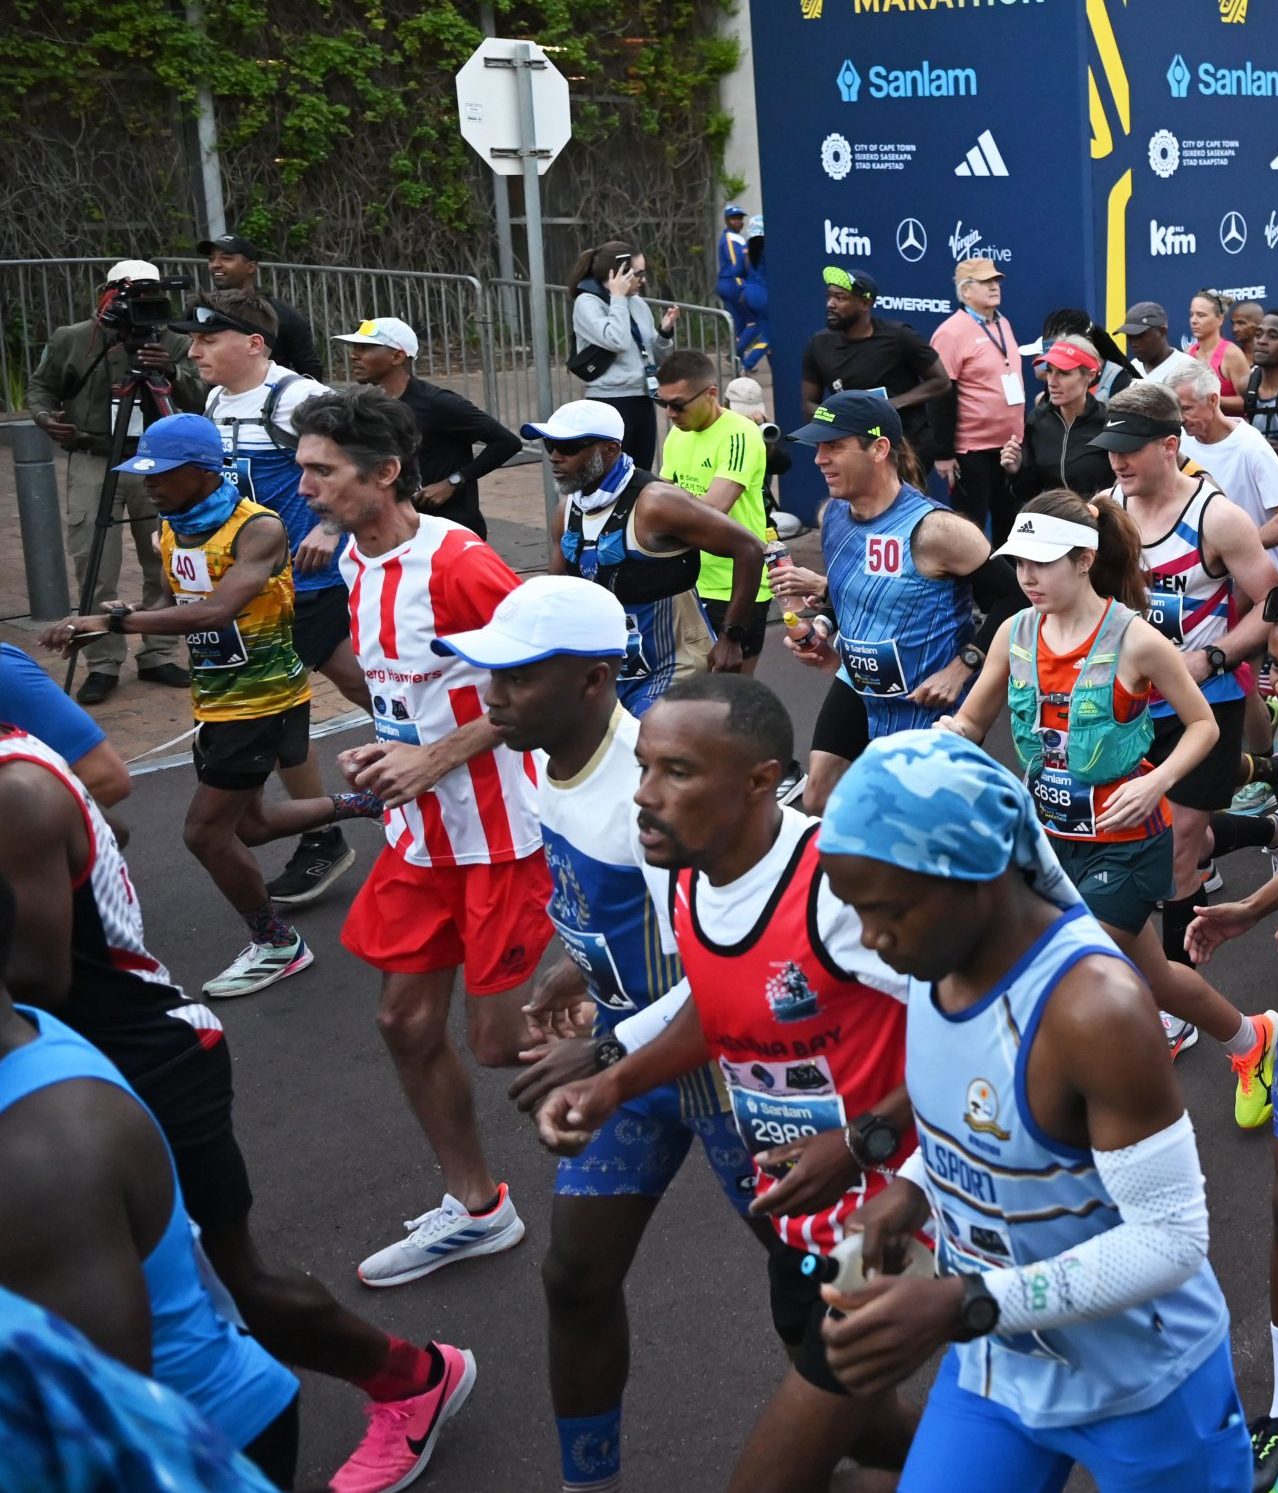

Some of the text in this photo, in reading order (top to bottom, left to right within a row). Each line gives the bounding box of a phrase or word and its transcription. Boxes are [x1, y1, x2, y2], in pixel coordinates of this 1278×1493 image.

[869, 60, 978, 98] Sanlam
[1182, 140, 1240, 148] CITY OF CAPE TOWN
[1183, 158, 1198, 166] STAD
[824, 219, 871, 256] kfm
[948, 220, 982, 261] Virgin
[1150, 219, 1196, 256] kfm
[972, 245, 1012, 262] active
[873, 296, 951, 313] POWERADE
[868, 538, 900, 573] 50
[176, 554, 196, 582] 40
[1152, 573, 1188, 593] EEN
[1146, 609, 1164, 624] 70
[850, 644, 878, 655] Sanlam
[848, 654, 879, 672] 2718
[1034, 780, 1071, 807] 2638
[760, 1102, 813, 1120] Sanlam
[935, 1148, 998, 1204] SPORT
